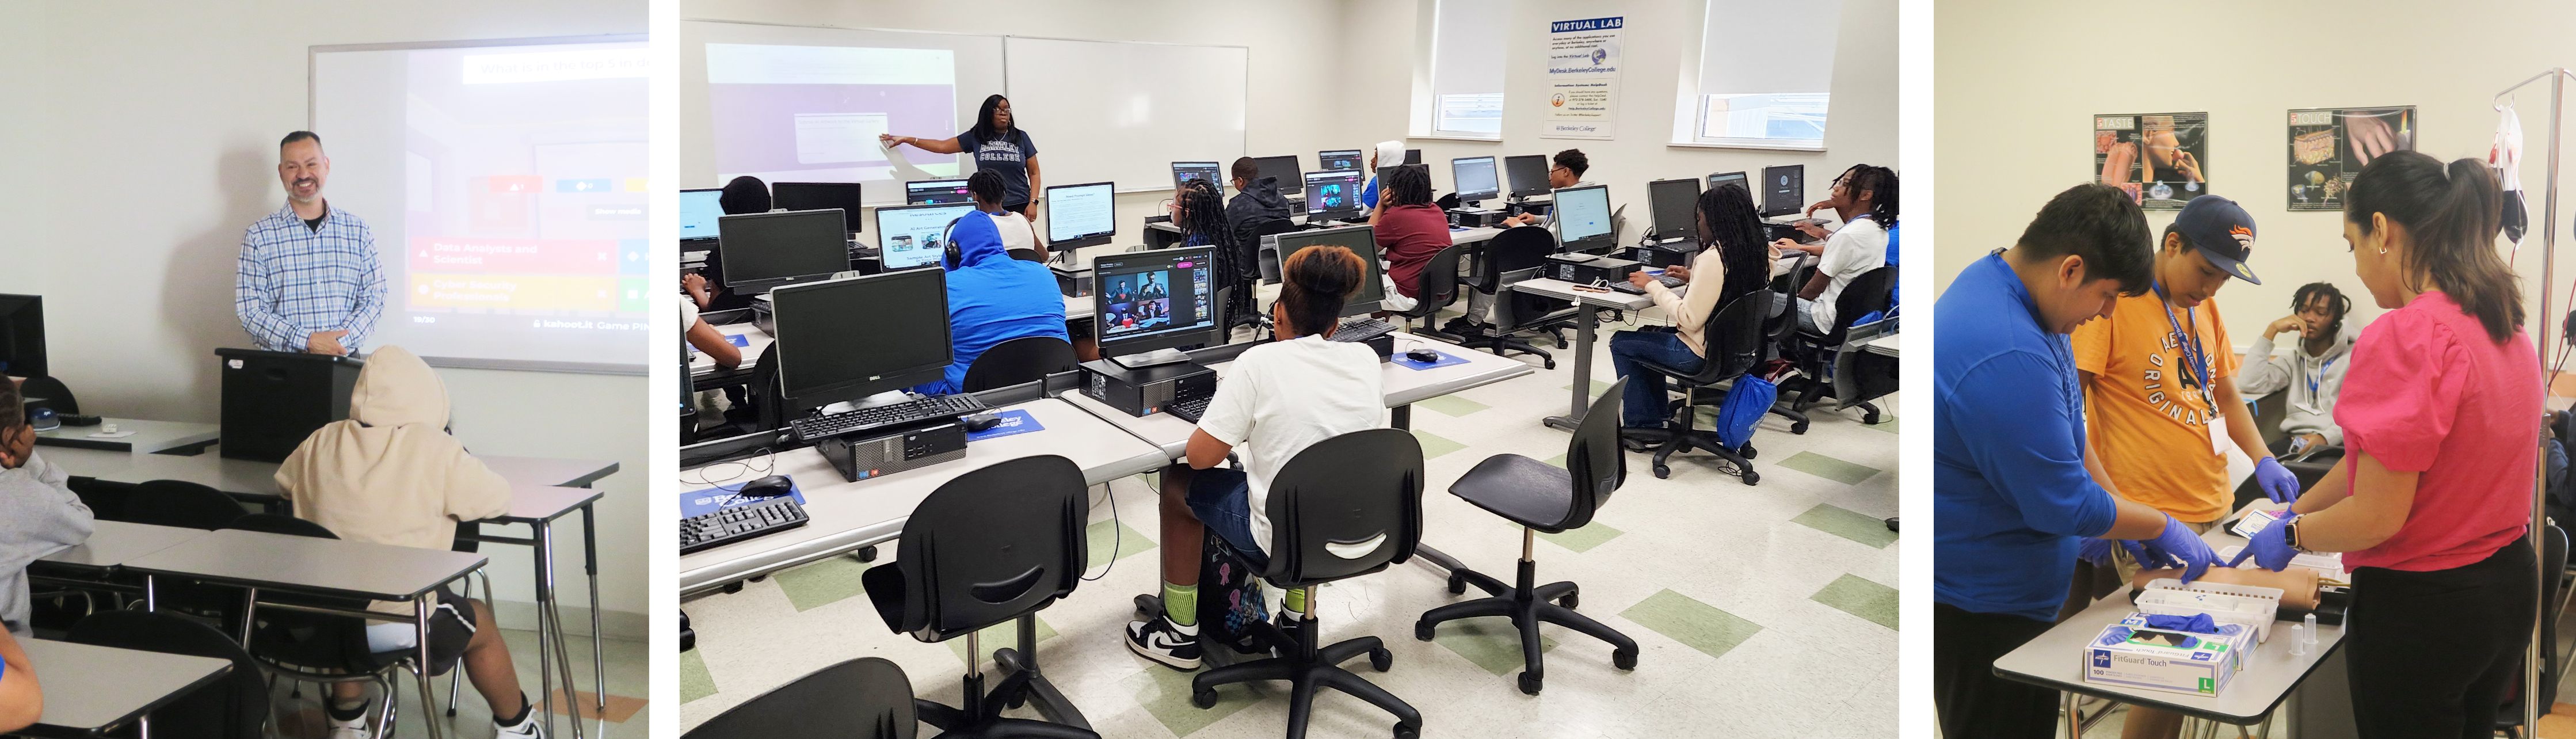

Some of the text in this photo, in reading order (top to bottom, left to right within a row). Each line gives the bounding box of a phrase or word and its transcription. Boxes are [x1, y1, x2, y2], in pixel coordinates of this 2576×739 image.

[1553, 18, 1621, 31] VIRTUAL LAB
[481, 63, 517, 73] What
[522, 62, 532, 72] is
[537, 62, 549, 71] in
[554, 59, 576, 70] the
[580, 59, 604, 71] top
[608, 59, 615, 68] 5
[620, 58, 632, 67] in
[2104, 118, 2133, 128] TASTE
[2297, 113, 2331, 124] TOUCH
[980, 140, 1019, 154] BERKELEY
[980, 153, 1020, 162] COLLEGE
[434, 243, 538, 255] Data Analysts and
[434, 254, 483, 265] Scientist
[434, 279, 517, 292] Cyber Security
[434, 291, 510, 302] Professionals
[543, 319, 593, 330] kahoot.it
[597, 321, 630, 331] Game
[2182, 341, 2199, 374] Berkeley College
[2176, 356, 2201, 390] A
[2114, 655, 2167, 667] FitGuard Touch
[2204, 679, 2210, 689] L
